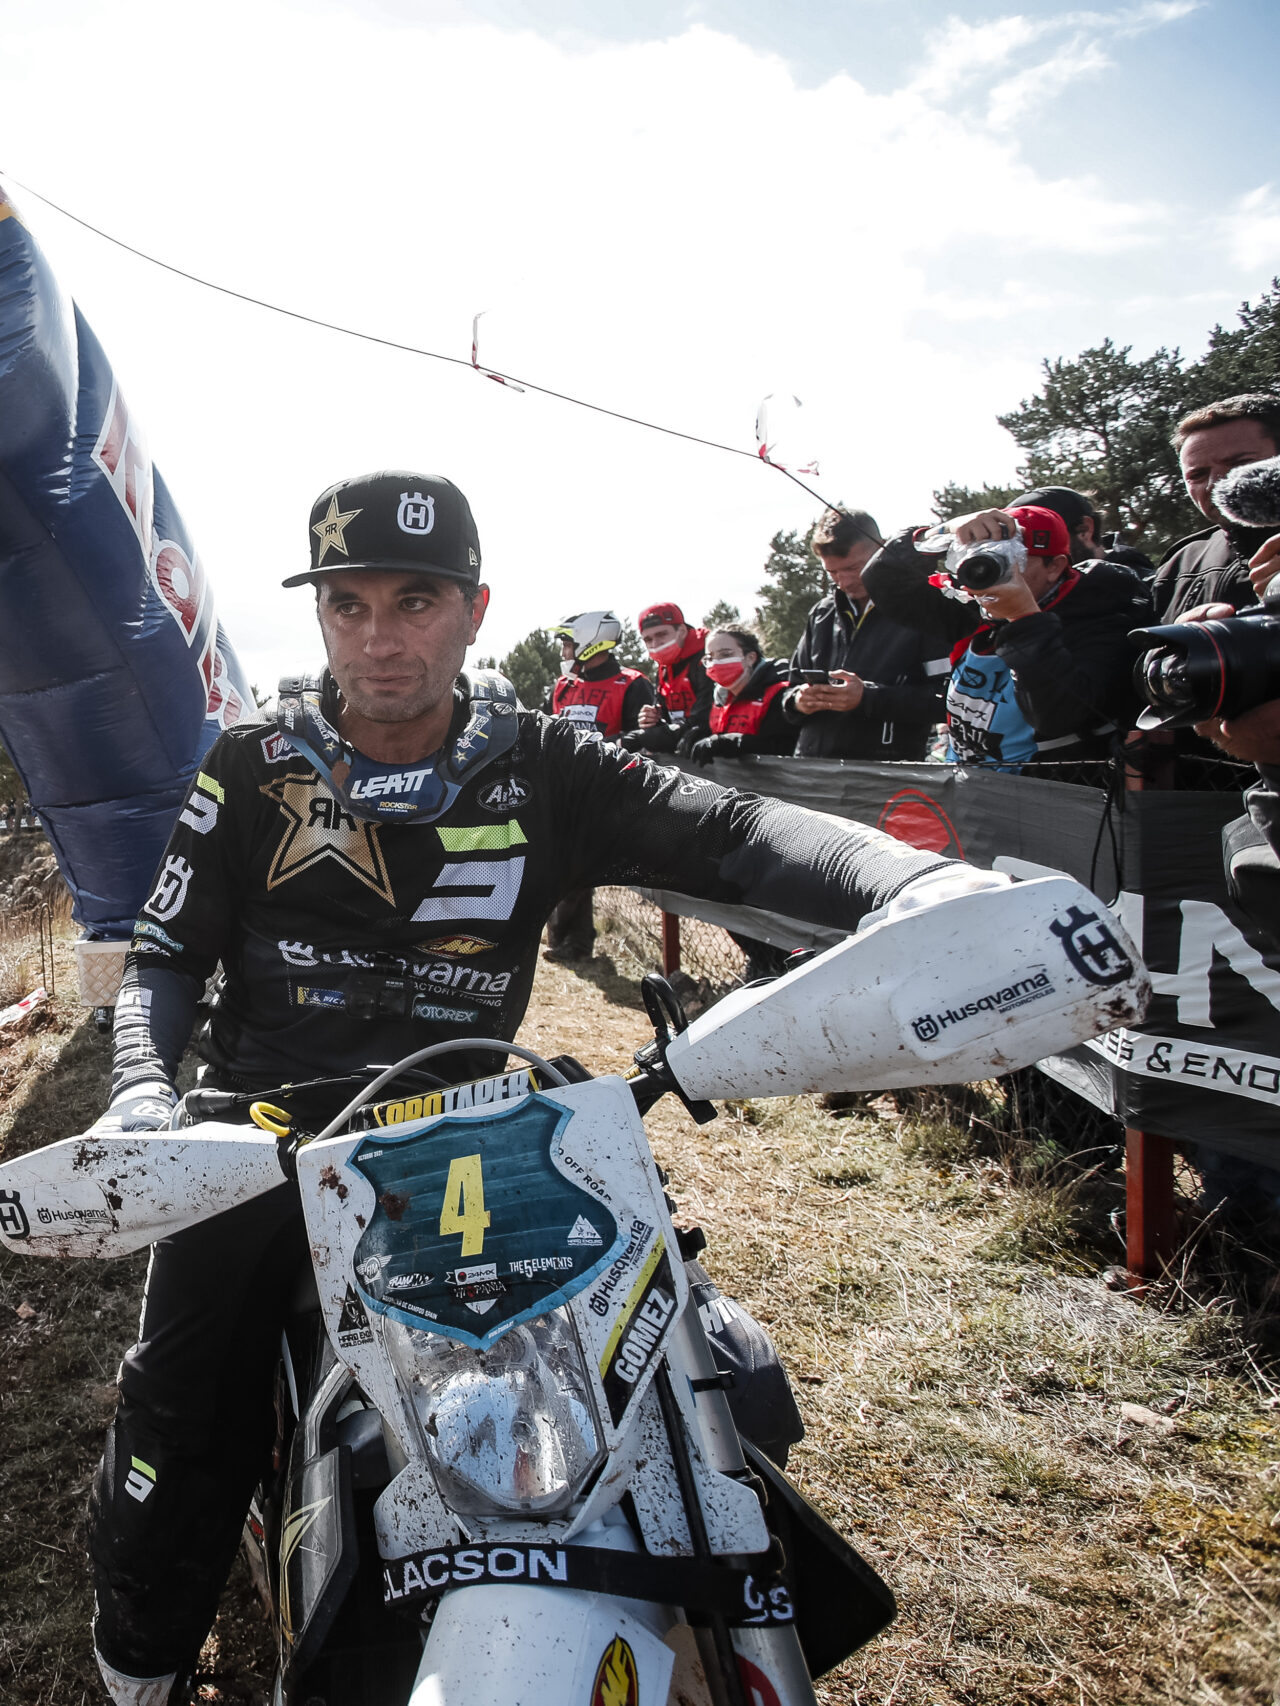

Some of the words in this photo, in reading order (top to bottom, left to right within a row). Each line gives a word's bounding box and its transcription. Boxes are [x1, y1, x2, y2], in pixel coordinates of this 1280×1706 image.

[350, 767, 434, 799] LEATT
[937, 973, 1050, 1029] Husqvarna
[999, 987, 1056, 1014] MOTORCYCLES
[564, 1156, 585, 1174] OFF
[51, 1208, 108, 1222] Husqvarna
[440, 1153, 491, 1257] 4
[615, 1287, 675, 1384] GOMEZ
